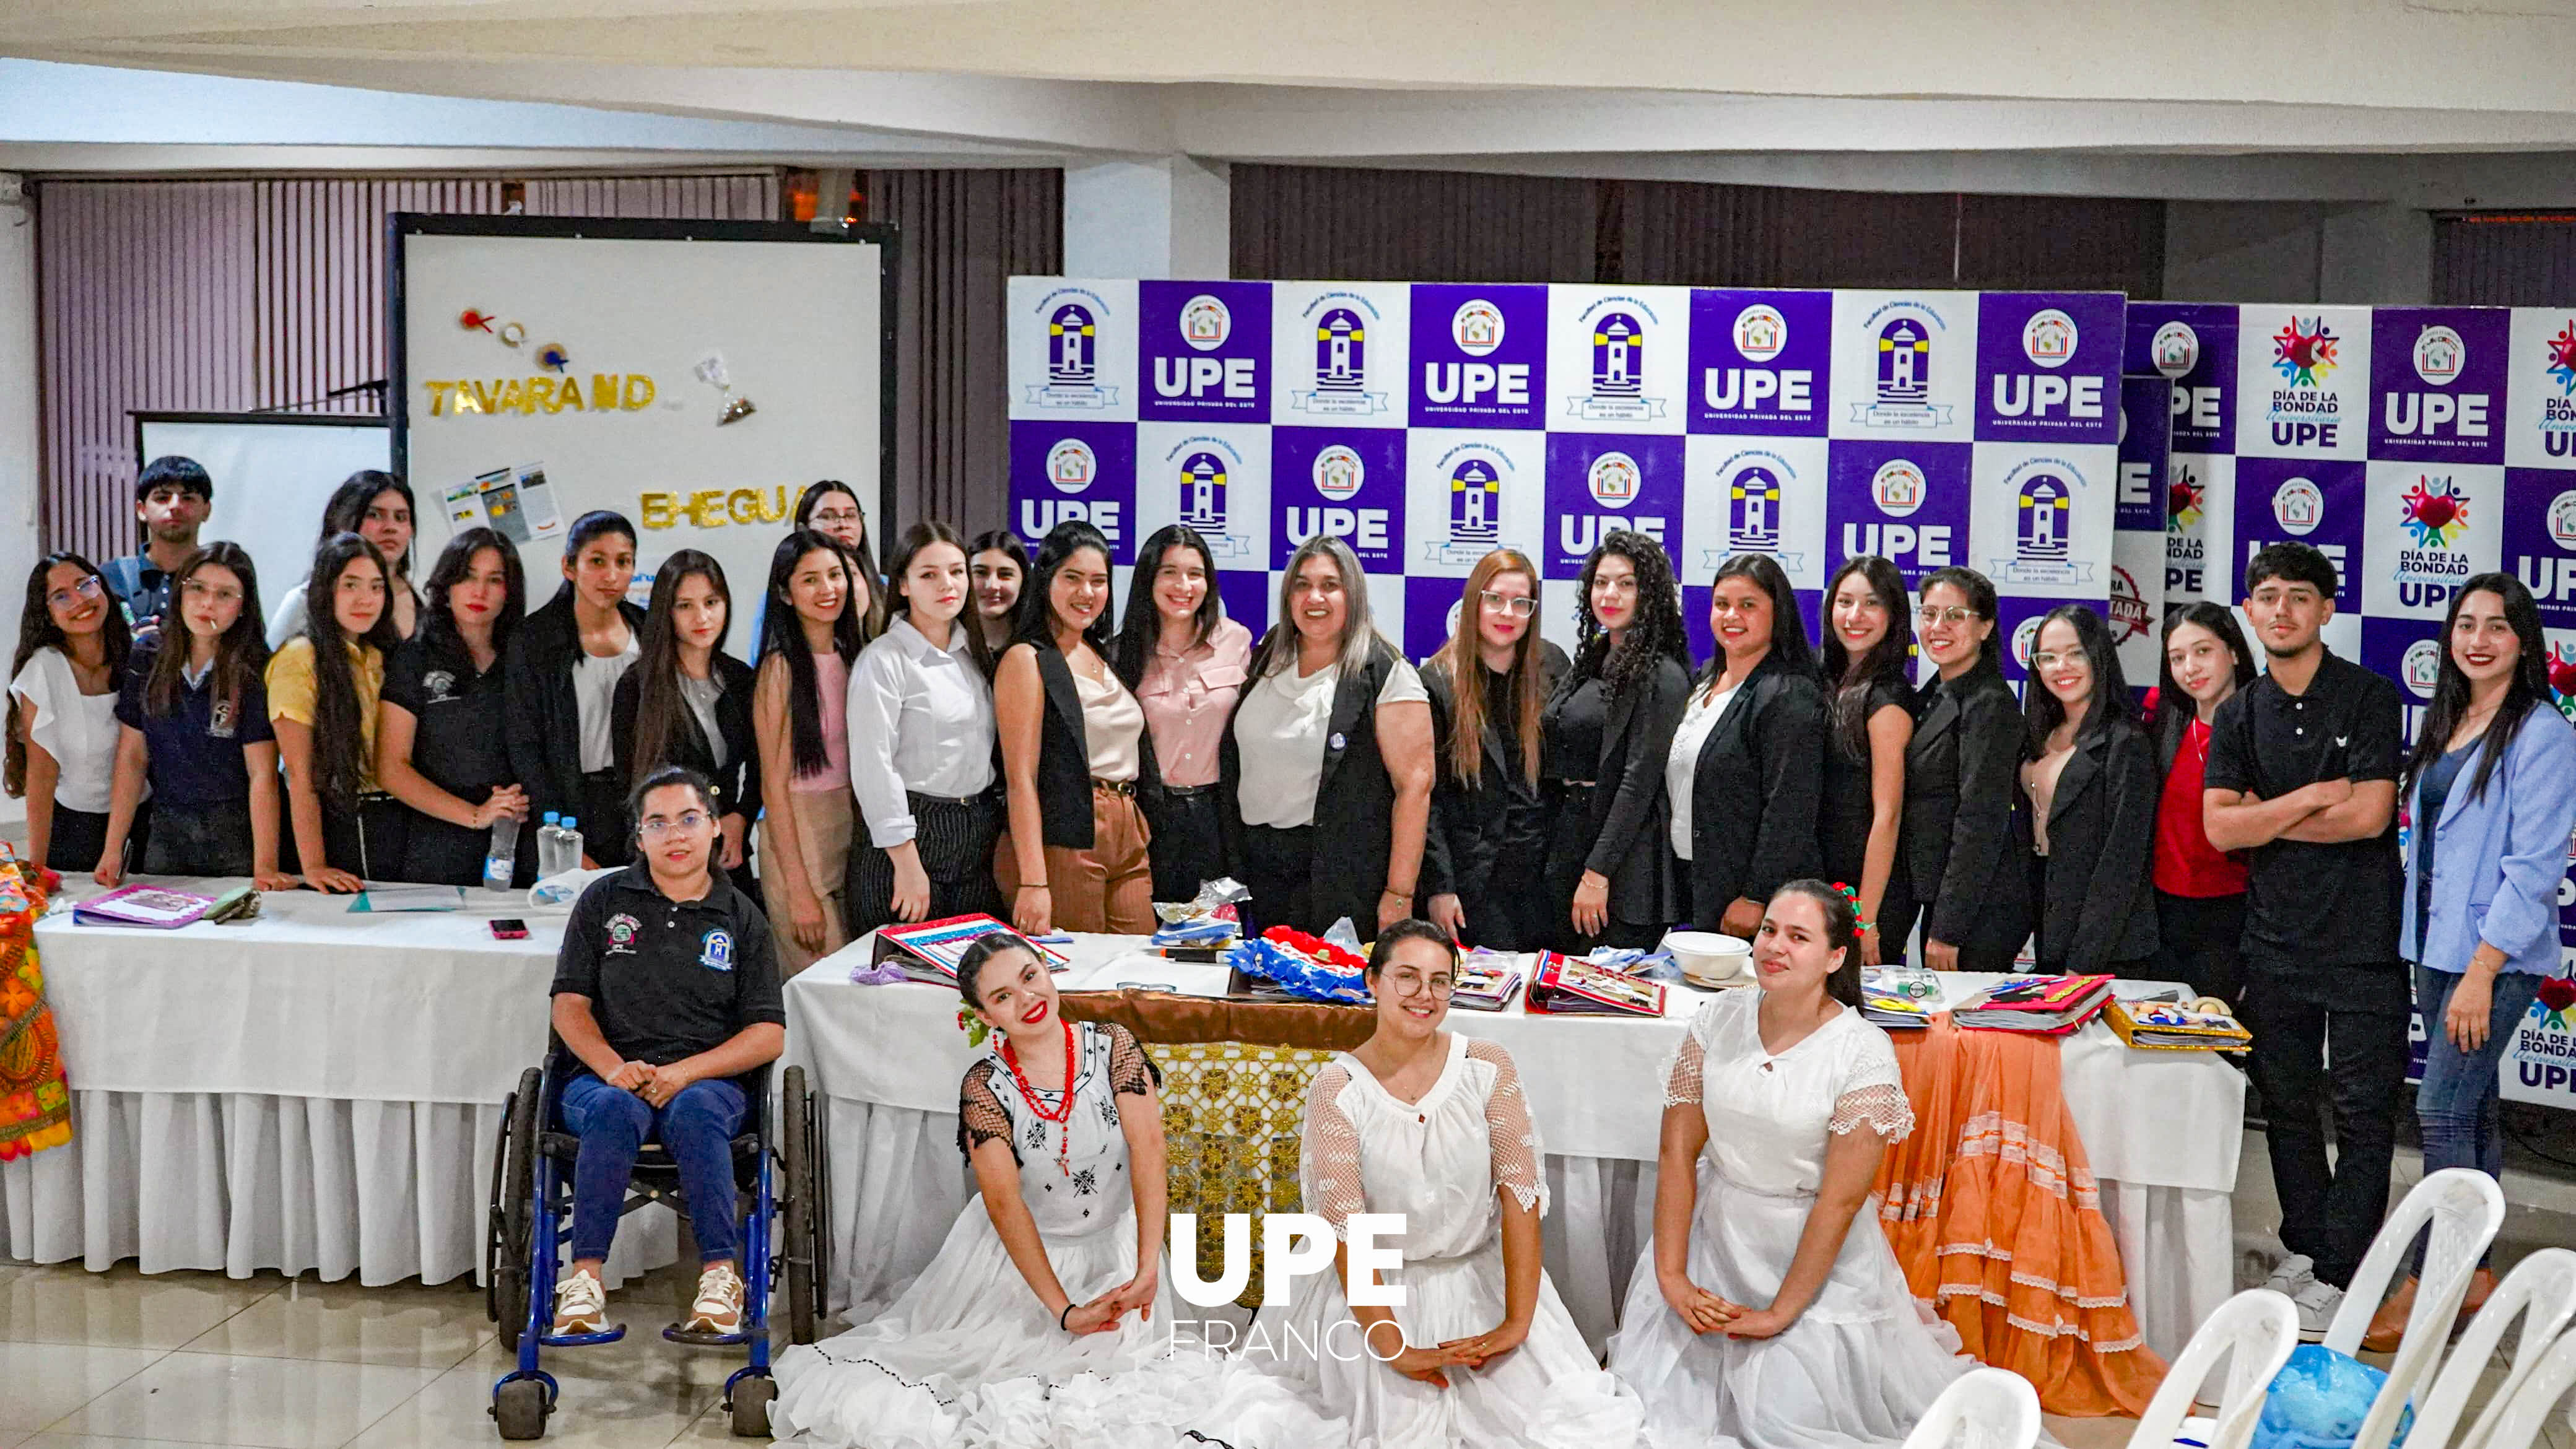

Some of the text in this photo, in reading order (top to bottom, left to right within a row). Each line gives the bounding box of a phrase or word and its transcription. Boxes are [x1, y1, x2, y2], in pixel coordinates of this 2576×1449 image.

[1154, 357, 1255, 398] UPE
[1425, 362, 1530, 404] UPE
[1705, 367, 1812, 411] UPE
[1994, 374, 2104, 417] UPE
[2173, 386, 2221, 427] PE
[2273, 389, 2338, 401] DÍA DE LA
[2273, 401, 2338, 413] BONDAD
[2547, 396, 2571, 409] DÍA
[2385, 392, 2489, 436] UPE
[2273, 422, 2338, 447] UPE
[1022, 499, 1120, 540] UPE
[1286, 507, 1388, 549] UPE
[1843, 523, 1951, 566] UPE
[2187, 538, 2203, 548] LA
[2401, 549, 2468, 564] DÍA DE LA
[2401, 562, 2468, 575] BONDAD
[2111, 580, 2123, 591] RA
[2165, 568, 2203, 592] PE
[2521, 1029, 2545, 1042] DÍA
[2550, 1034, 2568, 1045] DE
